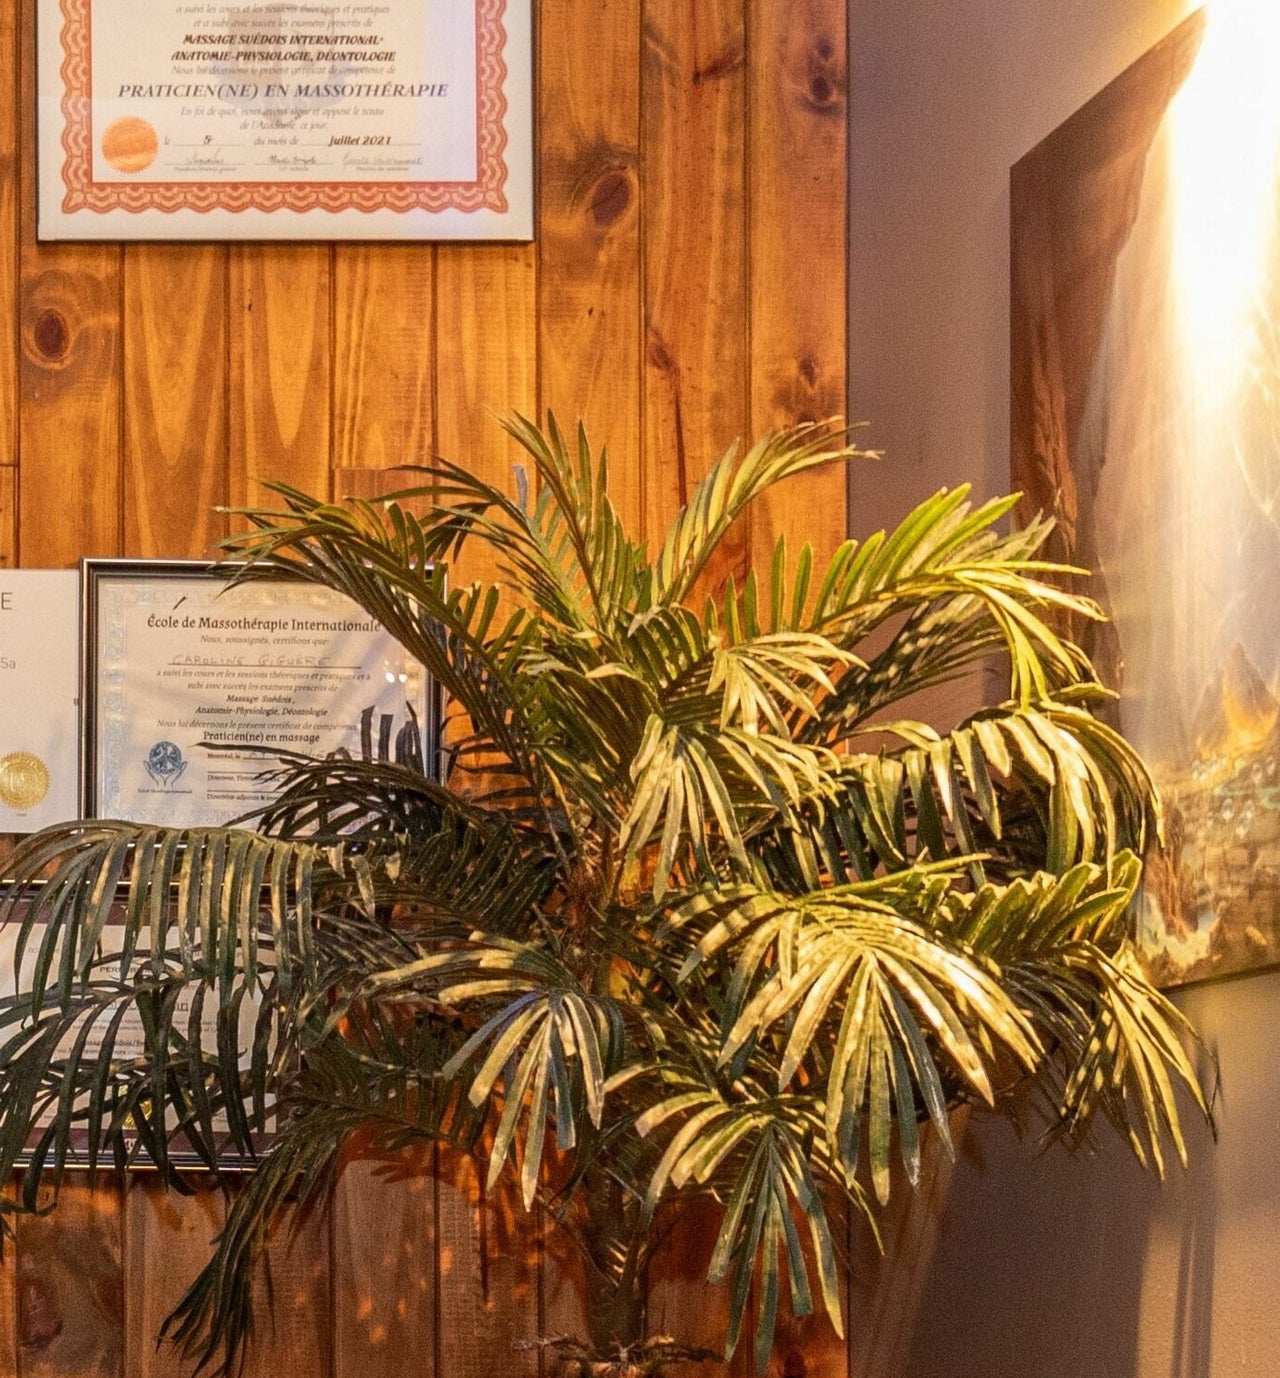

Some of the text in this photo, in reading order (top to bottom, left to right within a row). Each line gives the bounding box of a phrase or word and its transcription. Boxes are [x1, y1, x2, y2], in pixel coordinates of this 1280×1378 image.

[183, 34, 237, 45] MASSAGE
[238, 32, 287, 45] SUÉDOIS
[315, 50, 396, 62] DÉONTOLOGIE
[118, 84, 258, 99] PRATICIEN(NE)
[265, 85, 288, 98] EN
[361, 136, 392, 145] 2021
[147, 613, 381, 633] École de Massothérapie Internationale
[0, 657, 17, 670] Sa
[203, 731, 264, 742] Praticien(ne)
[279, 735, 320, 744] massage
